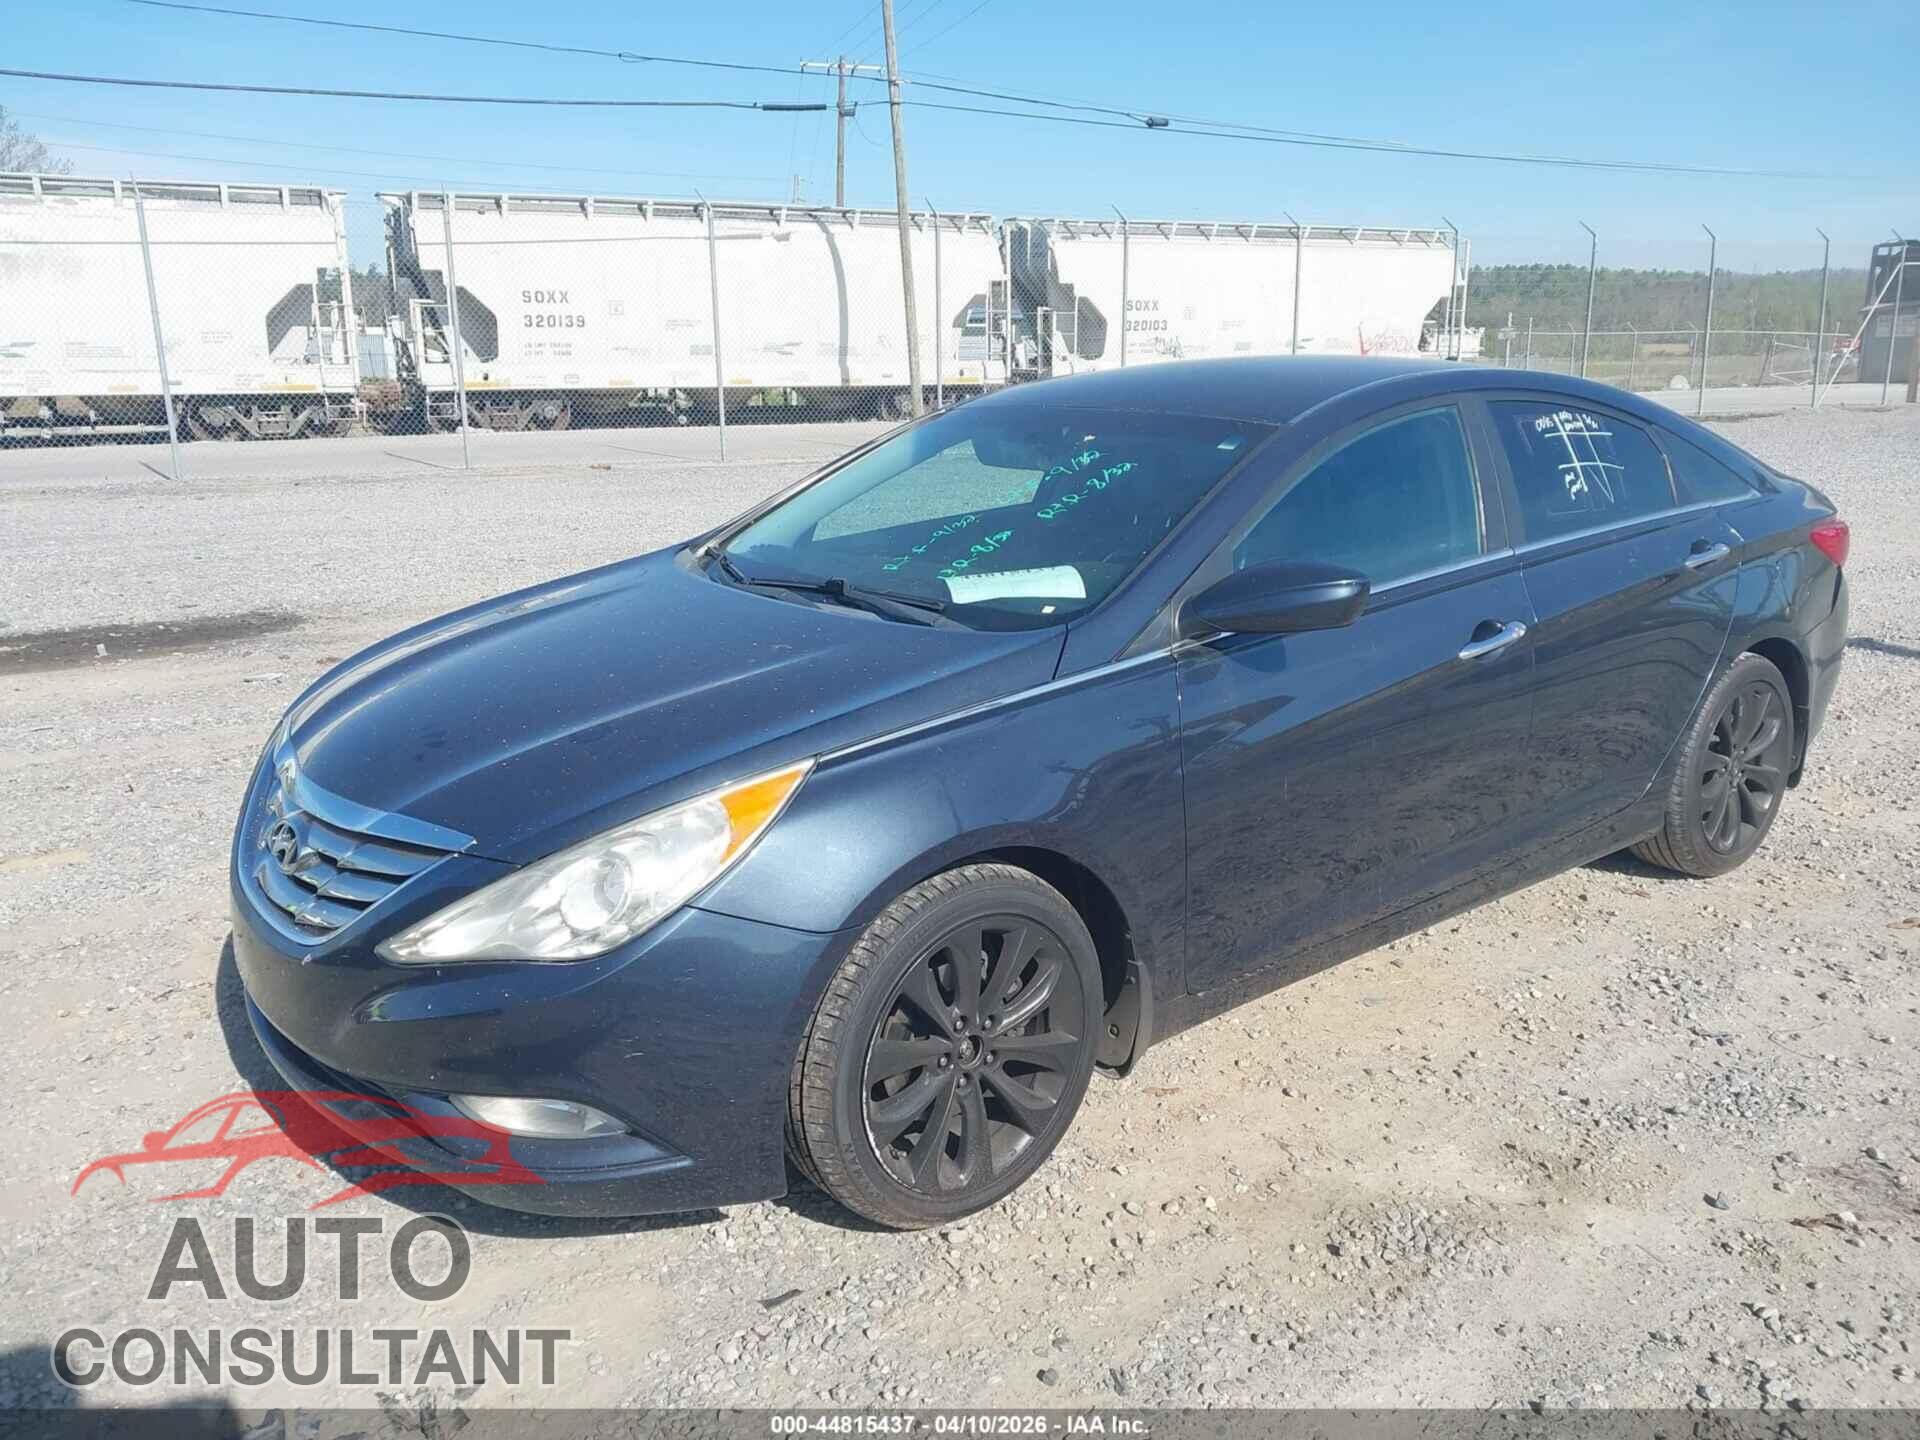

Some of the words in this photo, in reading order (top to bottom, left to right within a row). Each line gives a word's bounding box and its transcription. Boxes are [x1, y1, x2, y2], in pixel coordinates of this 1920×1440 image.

[522, 290, 570, 304] SOXX
[1126, 299, 1160, 312] SOXX
[523, 314, 586, 329] 320139
[1125, 319, 1168, 332] 320103
